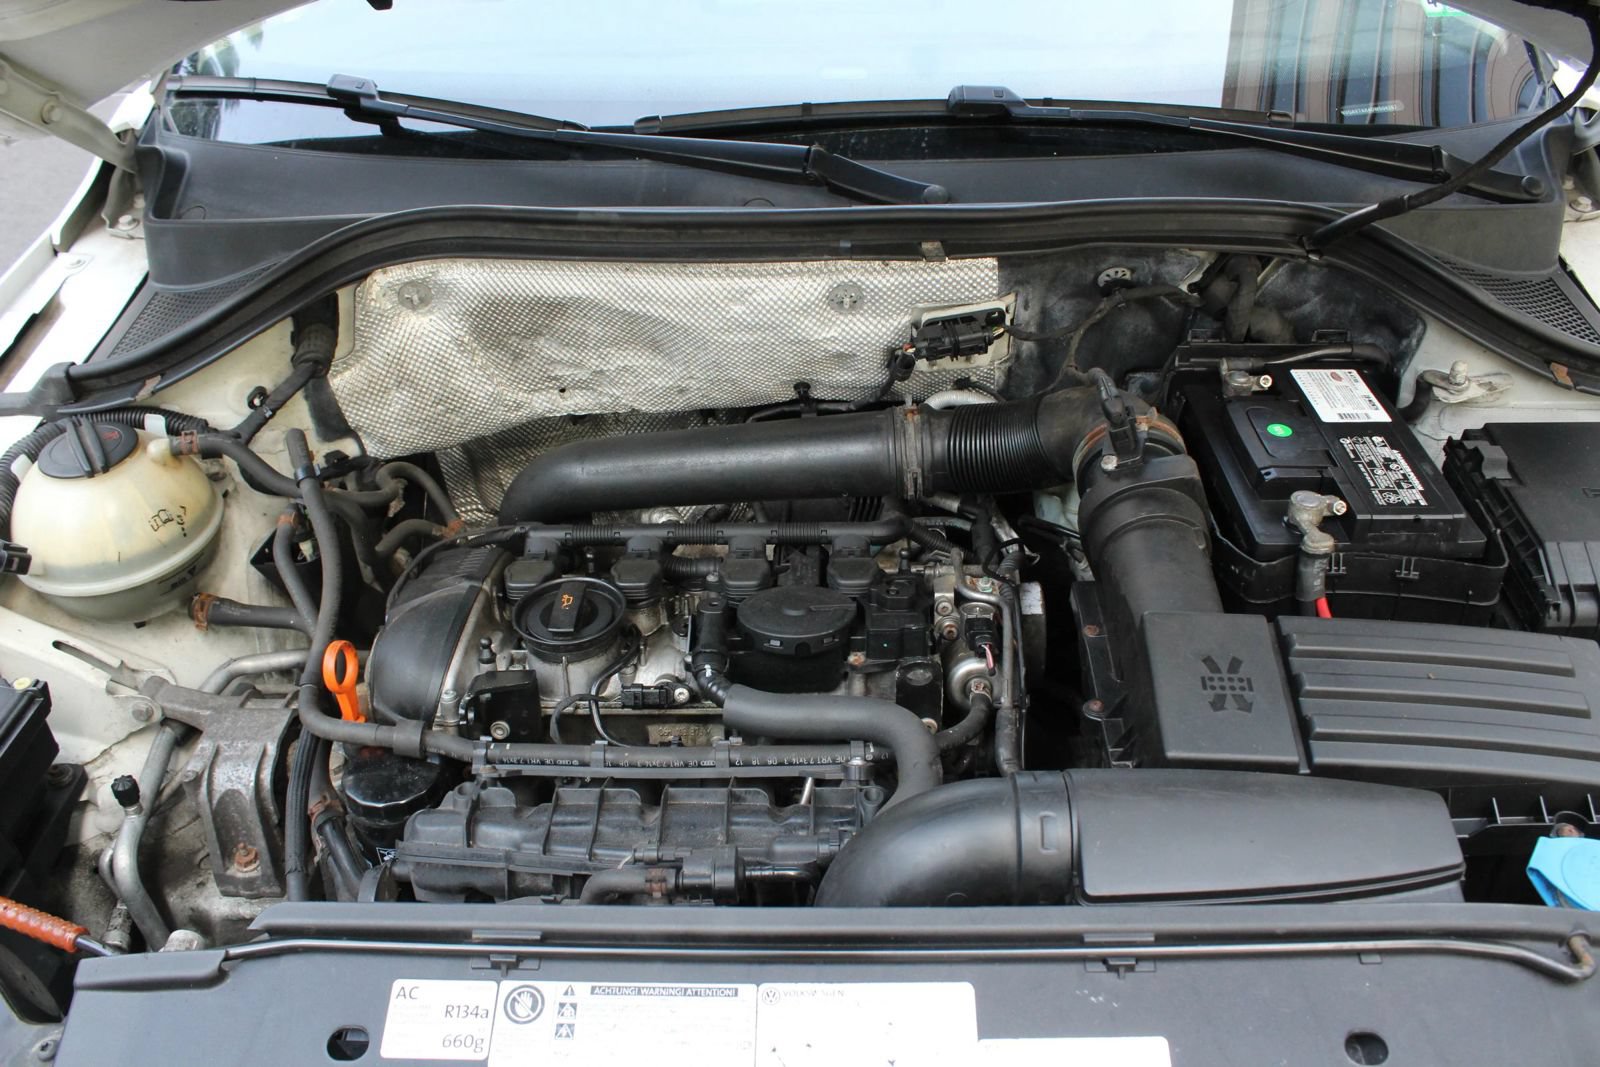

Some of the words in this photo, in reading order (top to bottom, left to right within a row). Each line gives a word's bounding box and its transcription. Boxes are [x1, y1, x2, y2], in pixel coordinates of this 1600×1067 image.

[395, 985, 420, 1000] AC
[593, 987, 638, 996] ACHTUNG!
[640, 987, 684, 996] WARNING!
[686, 988, 737, 997] ATTENTION!
[444, 1004, 490, 1019] R134a
[441, 1034, 485, 1054] 660g
